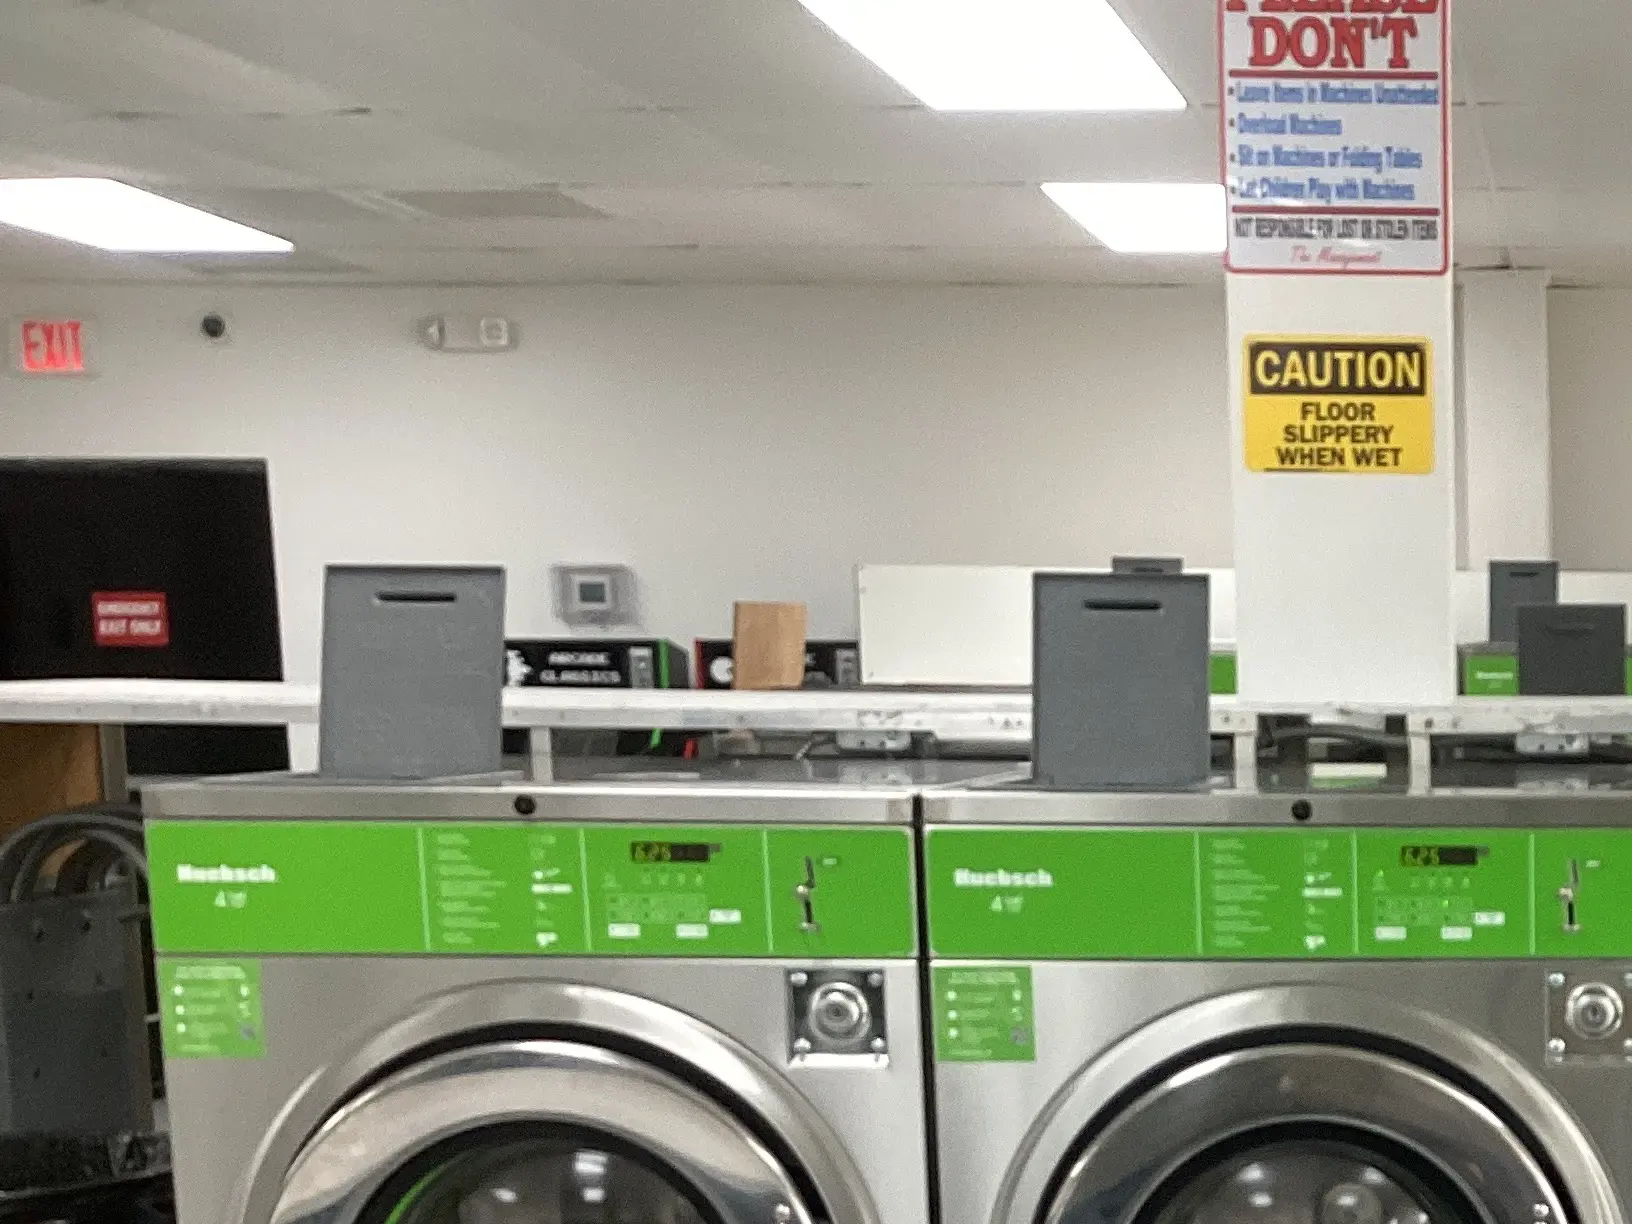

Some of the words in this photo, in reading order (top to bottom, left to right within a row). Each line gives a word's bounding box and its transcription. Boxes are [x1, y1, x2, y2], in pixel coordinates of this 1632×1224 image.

[1248, 16, 1418, 68] DON'T
[22, 321, 83, 373] EXIT
[1254, 350, 1421, 388] CAUTION
[1300, 402, 1375, 421] FLOOR
[1283, 425, 1395, 444] SLIPPERY
[1275, 447, 1345, 467] WHEN
[1351, 448, 1404, 467] WET
